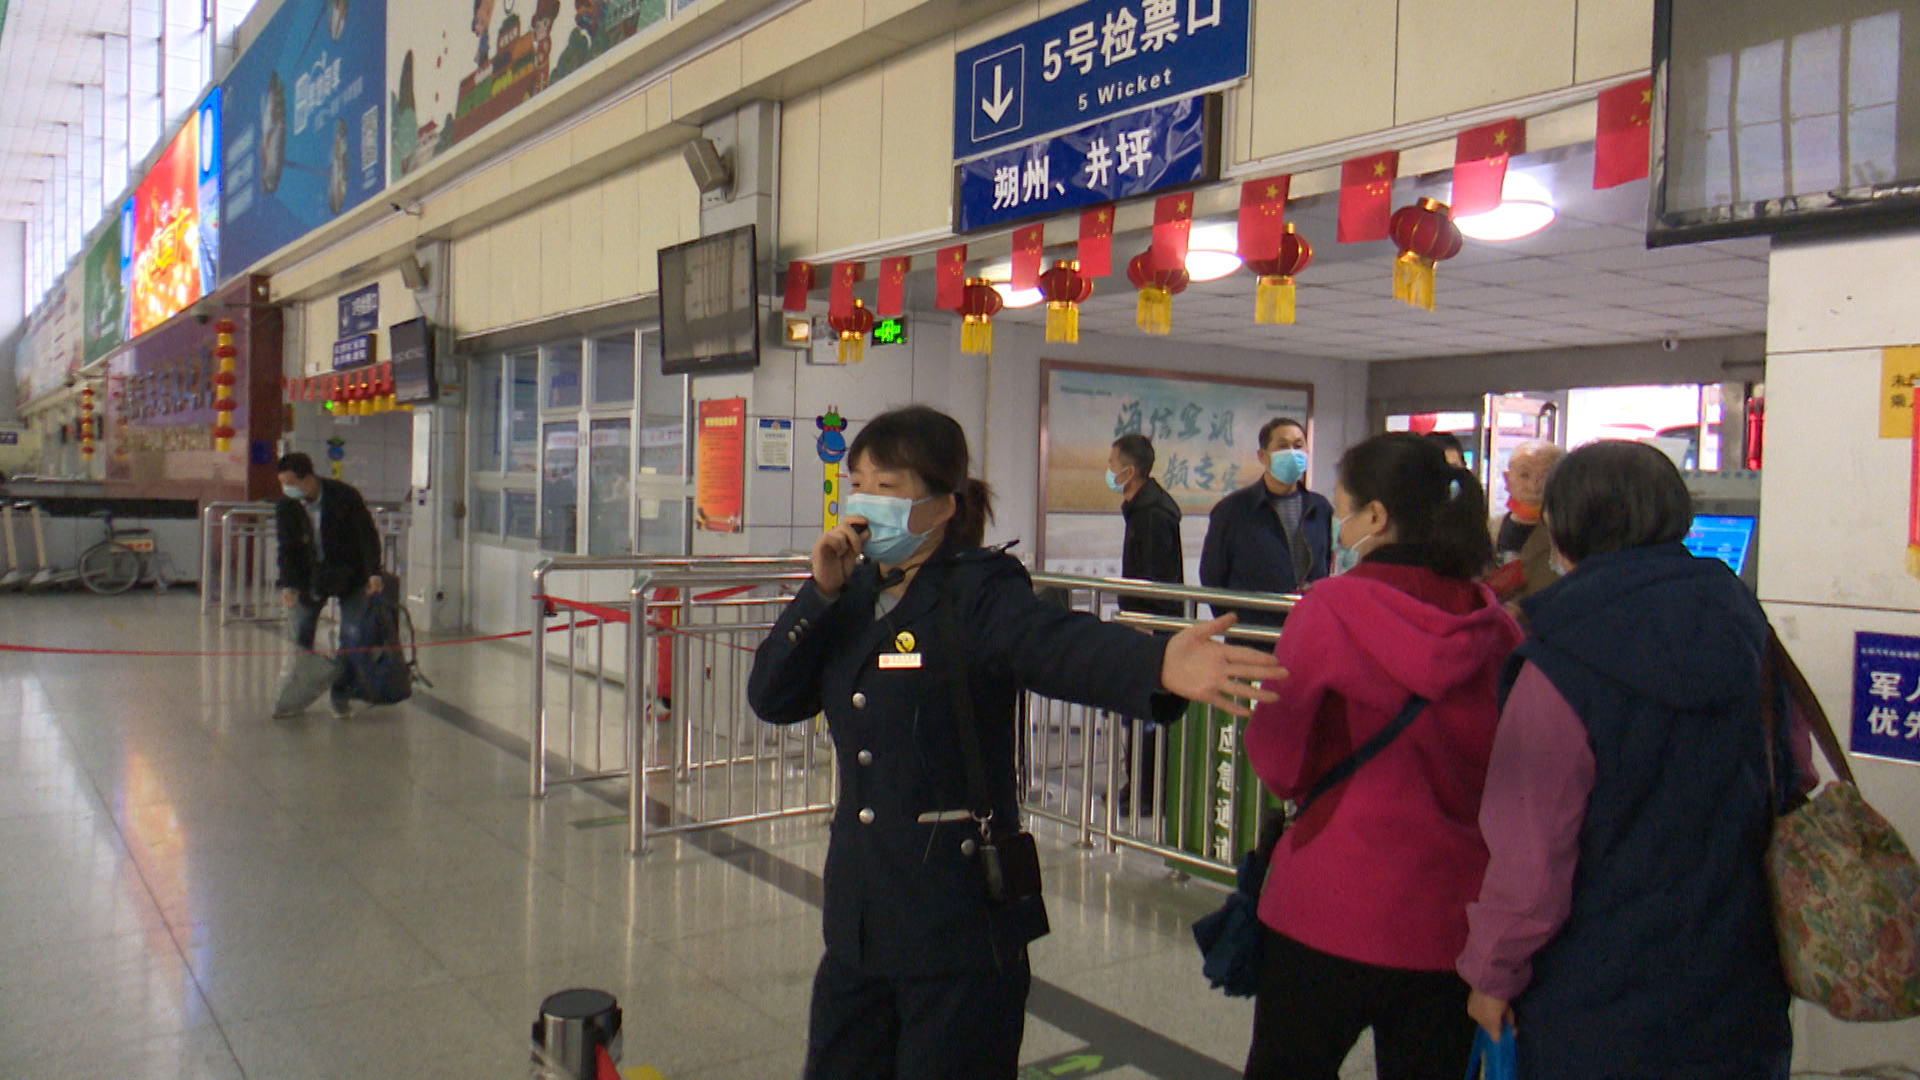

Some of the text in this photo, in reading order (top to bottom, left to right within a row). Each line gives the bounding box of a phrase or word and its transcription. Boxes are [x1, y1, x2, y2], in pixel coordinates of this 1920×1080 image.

[1043, 0, 1221, 82] 5号检票口
[1077, 67, 1172, 111] 5 Wicket
[992, 128, 1153, 210] 朔州、井坪
